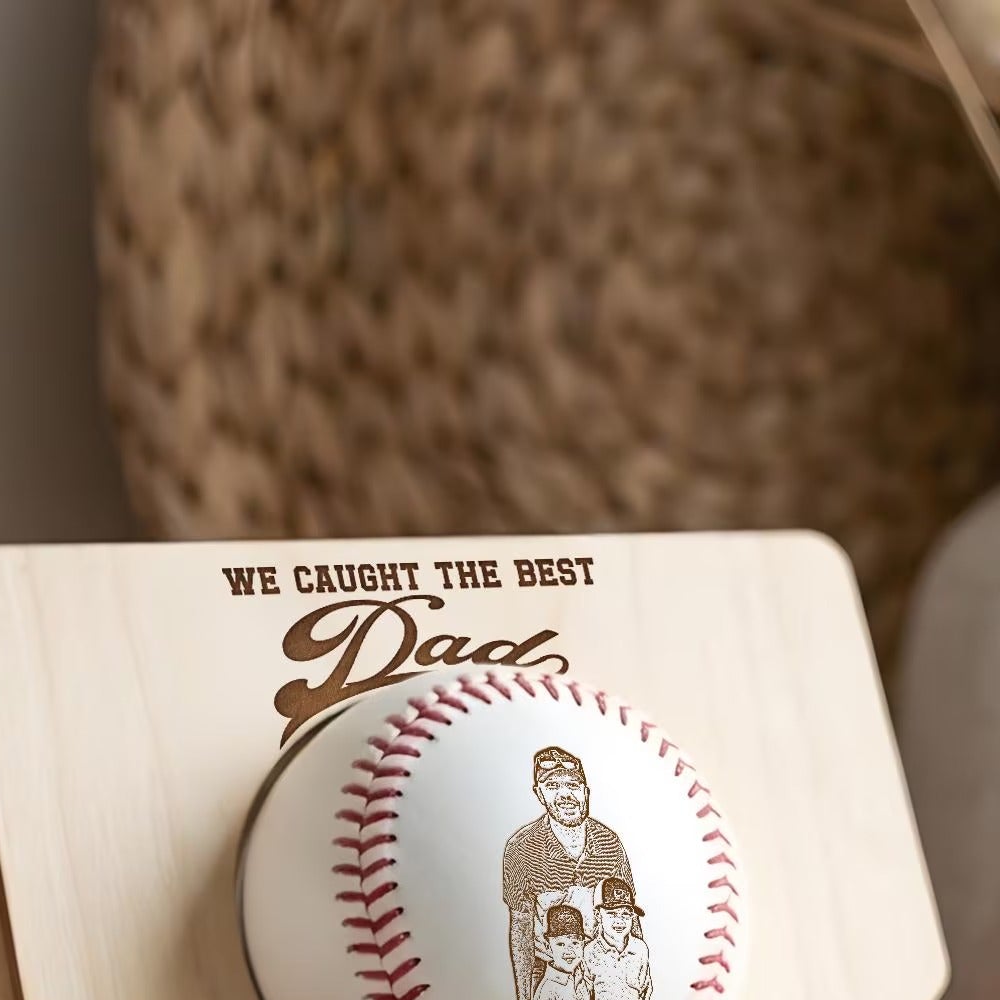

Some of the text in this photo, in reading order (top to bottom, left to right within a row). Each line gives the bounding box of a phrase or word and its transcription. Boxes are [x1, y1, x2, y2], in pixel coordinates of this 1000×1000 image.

[222, 557, 594, 596] WE CAUGHT THE BEST
[274, 594, 569, 750] Dad
